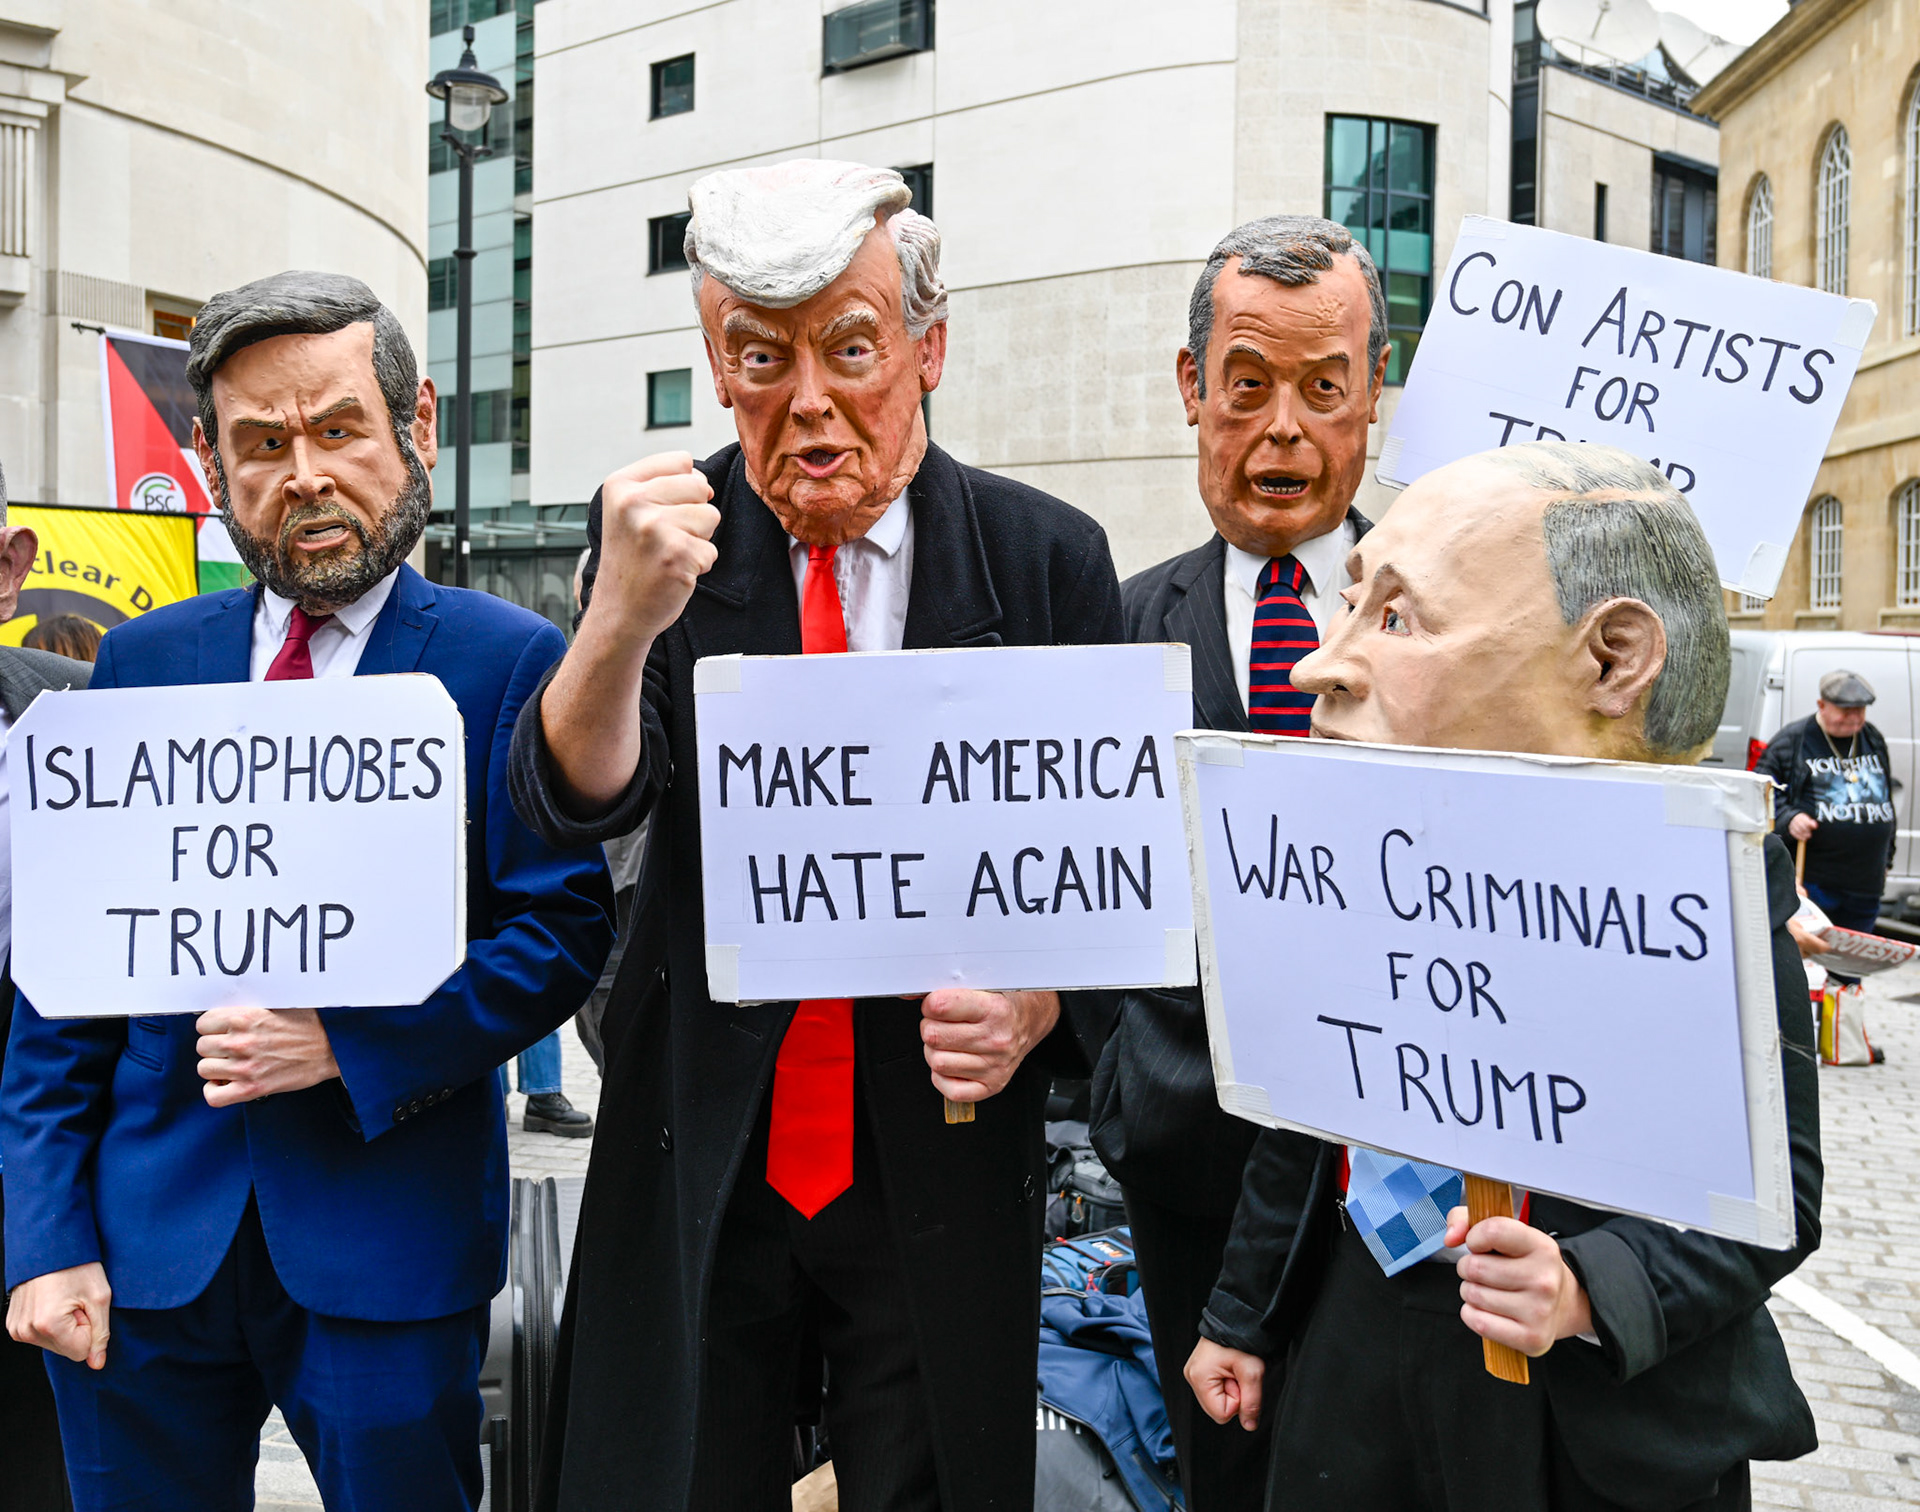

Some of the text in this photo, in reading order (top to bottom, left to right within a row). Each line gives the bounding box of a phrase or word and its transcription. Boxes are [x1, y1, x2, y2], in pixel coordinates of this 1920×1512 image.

[1448, 251, 1835, 404] CON ARTISTS
[1565, 366, 1660, 433] FOR
[144, 494, 175, 512] PSC
[26, 734, 446, 811] ISLAMOPHOBES
[718, 735, 1165, 808] MAKE AMERICA
[1805, 756, 1841, 777] YOU
[1816, 801, 1864, 824] NOT
[172, 823, 278, 882] FOR
[748, 845, 1152, 924] HATE AGAIN
[1222, 808, 1709, 961] WAR CRIMINALS
[106, 903, 355, 977] TRUMP
[1386, 951, 1507, 1024] FOR
[1317, 1014, 1587, 1144] TRUMP
